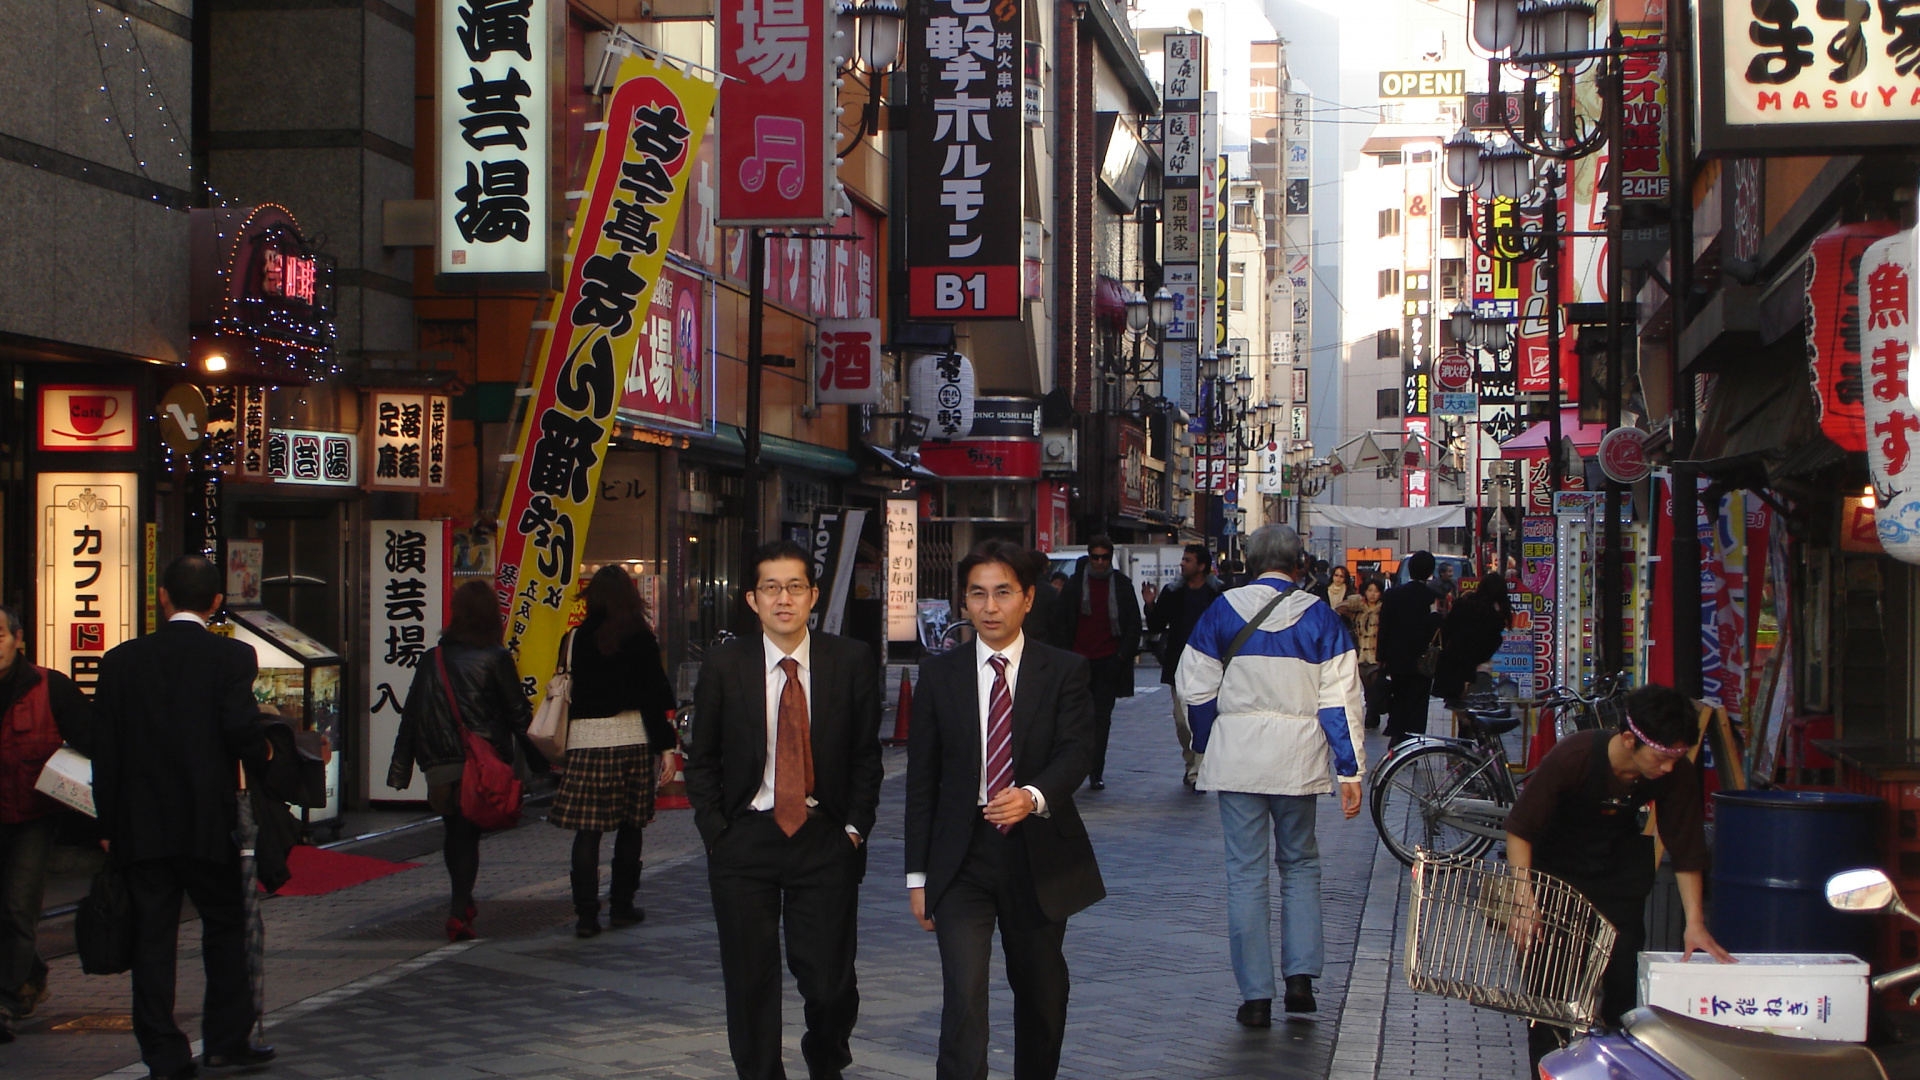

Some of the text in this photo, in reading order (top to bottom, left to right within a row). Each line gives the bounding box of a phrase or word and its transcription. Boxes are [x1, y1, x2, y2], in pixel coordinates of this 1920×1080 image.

[1382, 72, 1462, 96] OPEN!
[1757, 86, 1920, 111] MASUYA
[454, 0, 532, 243] 演芸場
[1173, 196, 1188, 251] 酒菜家
[936, 275, 986, 309] B1
[819, 331, 872, 390] 酒
[1441, 364, 1469, 378] 消火栓
[1867, 262, 1920, 477] 魚ます
[1433, 394, 1445, 410] 質
[385, 530, 427, 668] 演芸場
[1711, 995, 1808, 1017] 万能ねぎ
